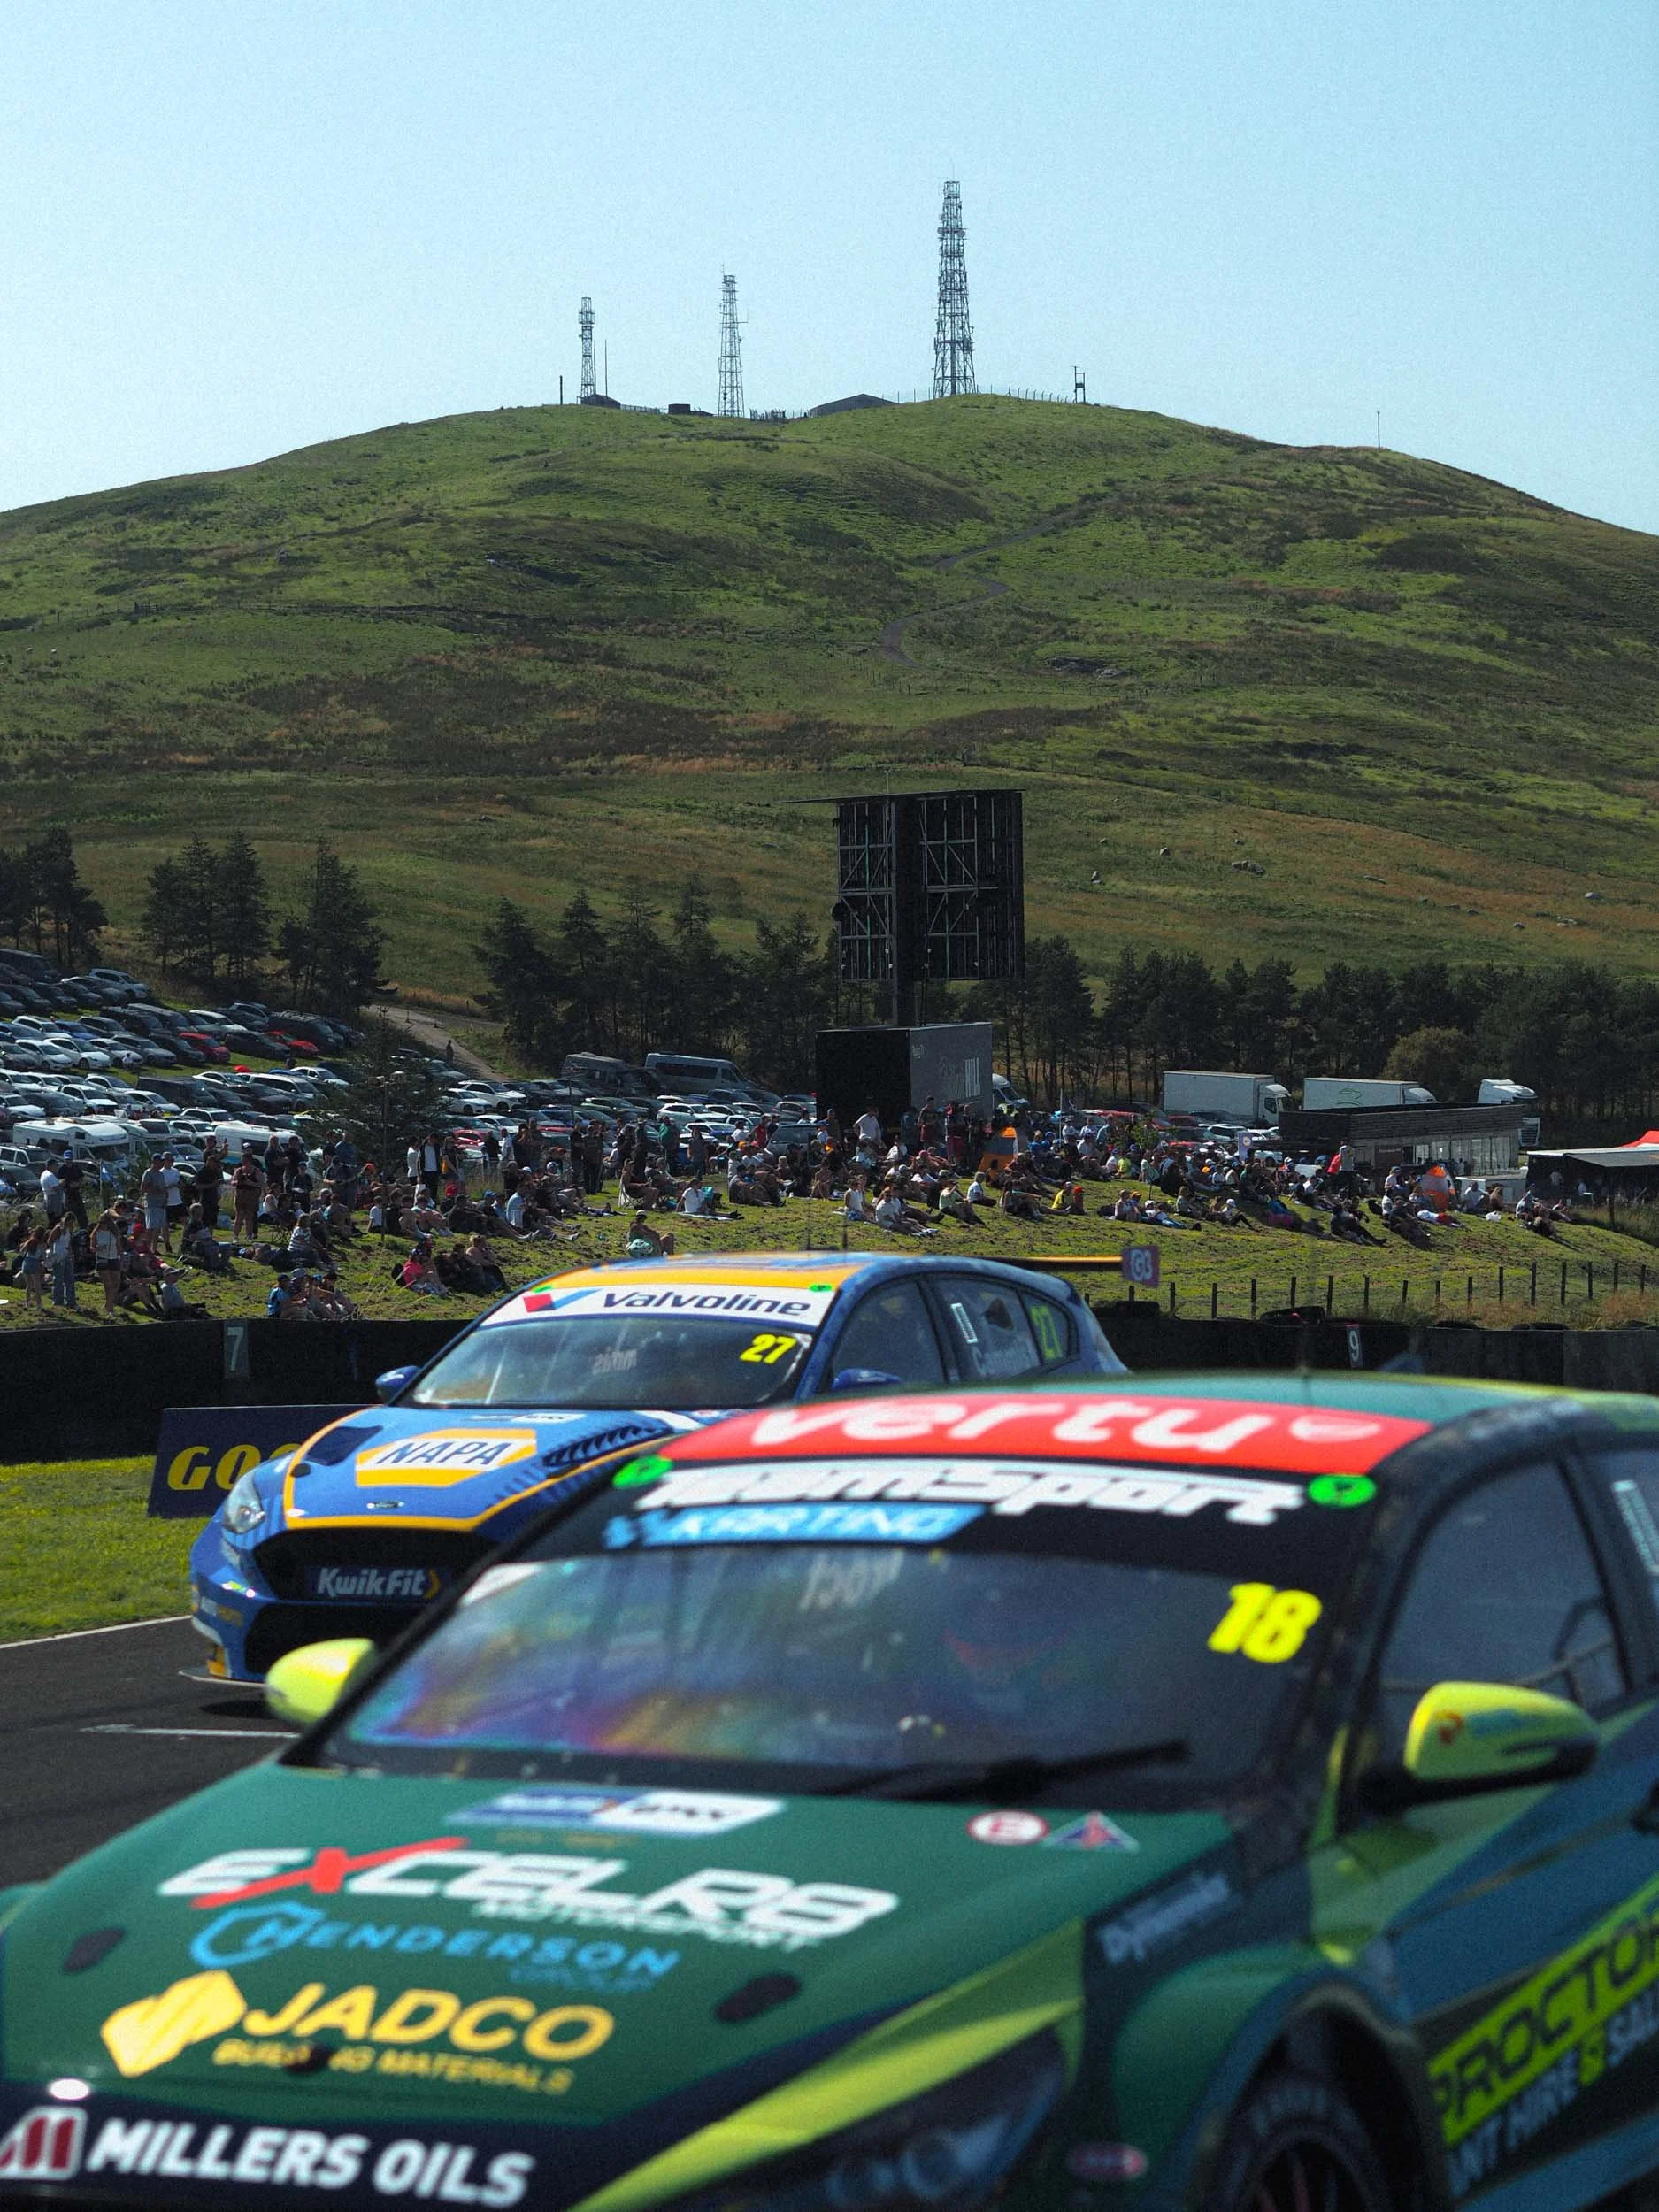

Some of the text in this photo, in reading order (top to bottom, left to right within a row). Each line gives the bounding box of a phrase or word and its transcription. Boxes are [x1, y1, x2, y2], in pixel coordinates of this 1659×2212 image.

[602, 1290, 812, 1316] Valvoline
[227, 1326, 245, 1371] 7
[739, 1333, 797, 1365] 27
[1348, 1330, 1360, 1363] 9
[751, 1401, 1274, 1453] vertu
[166, 1443, 301, 1491] GO
[375, 1441, 515, 1465] NAPA
[1208, 1582, 1323, 1663] 18
[243, 1983, 614, 2062] JADCO
[1429, 1911, 1659, 2120] PROCTO
[87, 2117, 534, 2209] MILLERS OILS
